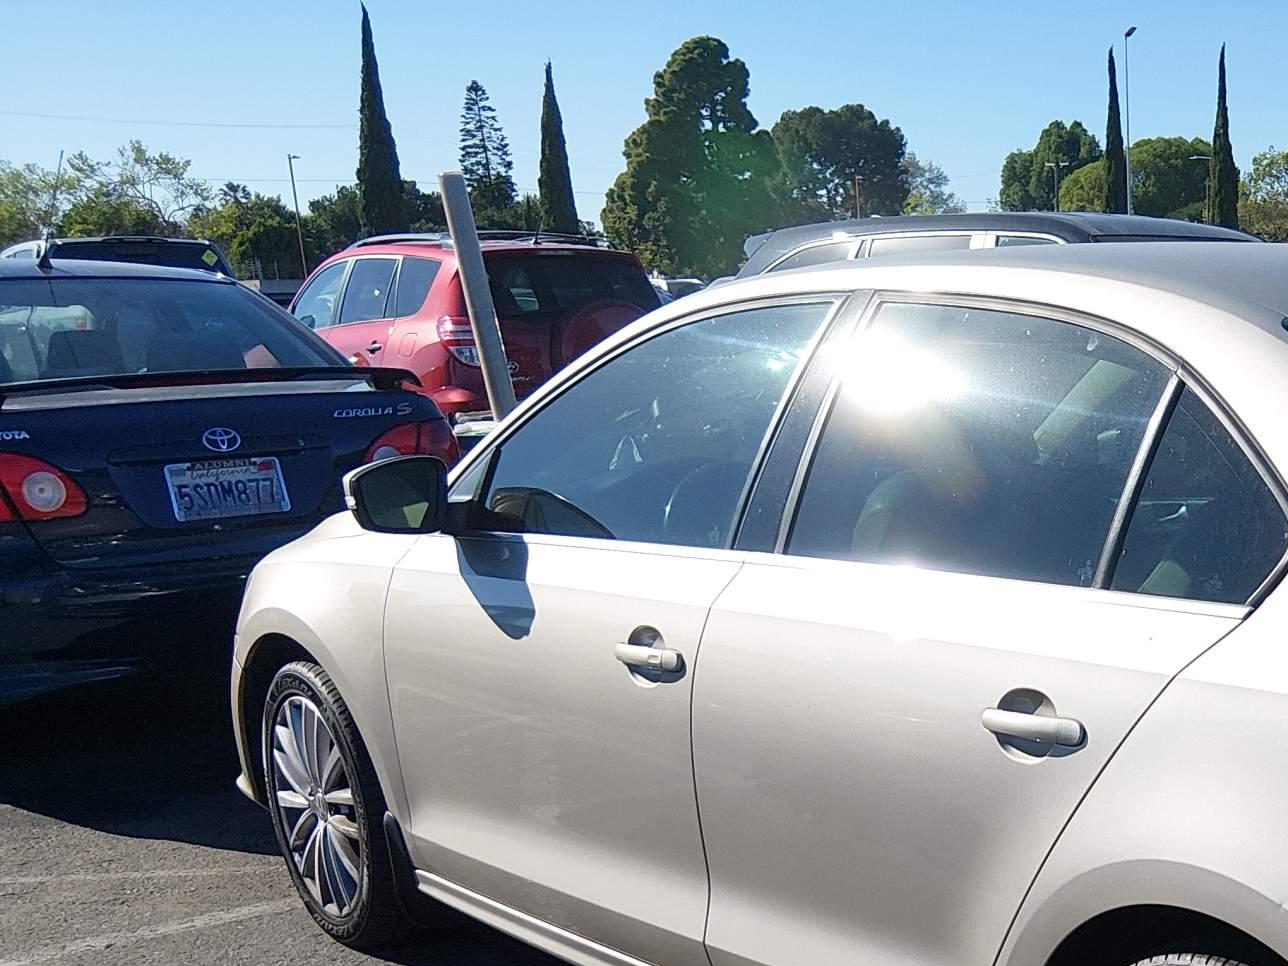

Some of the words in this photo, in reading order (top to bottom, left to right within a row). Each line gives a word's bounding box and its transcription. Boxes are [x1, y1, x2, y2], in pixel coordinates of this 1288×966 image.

[333, 407, 393, 417] COROLLA
[397, 402, 412, 416] S
[194, 459, 251, 470] ALUMNI
[191, 467, 258, 481] California
[176, 477, 276, 511] 5SDM877
